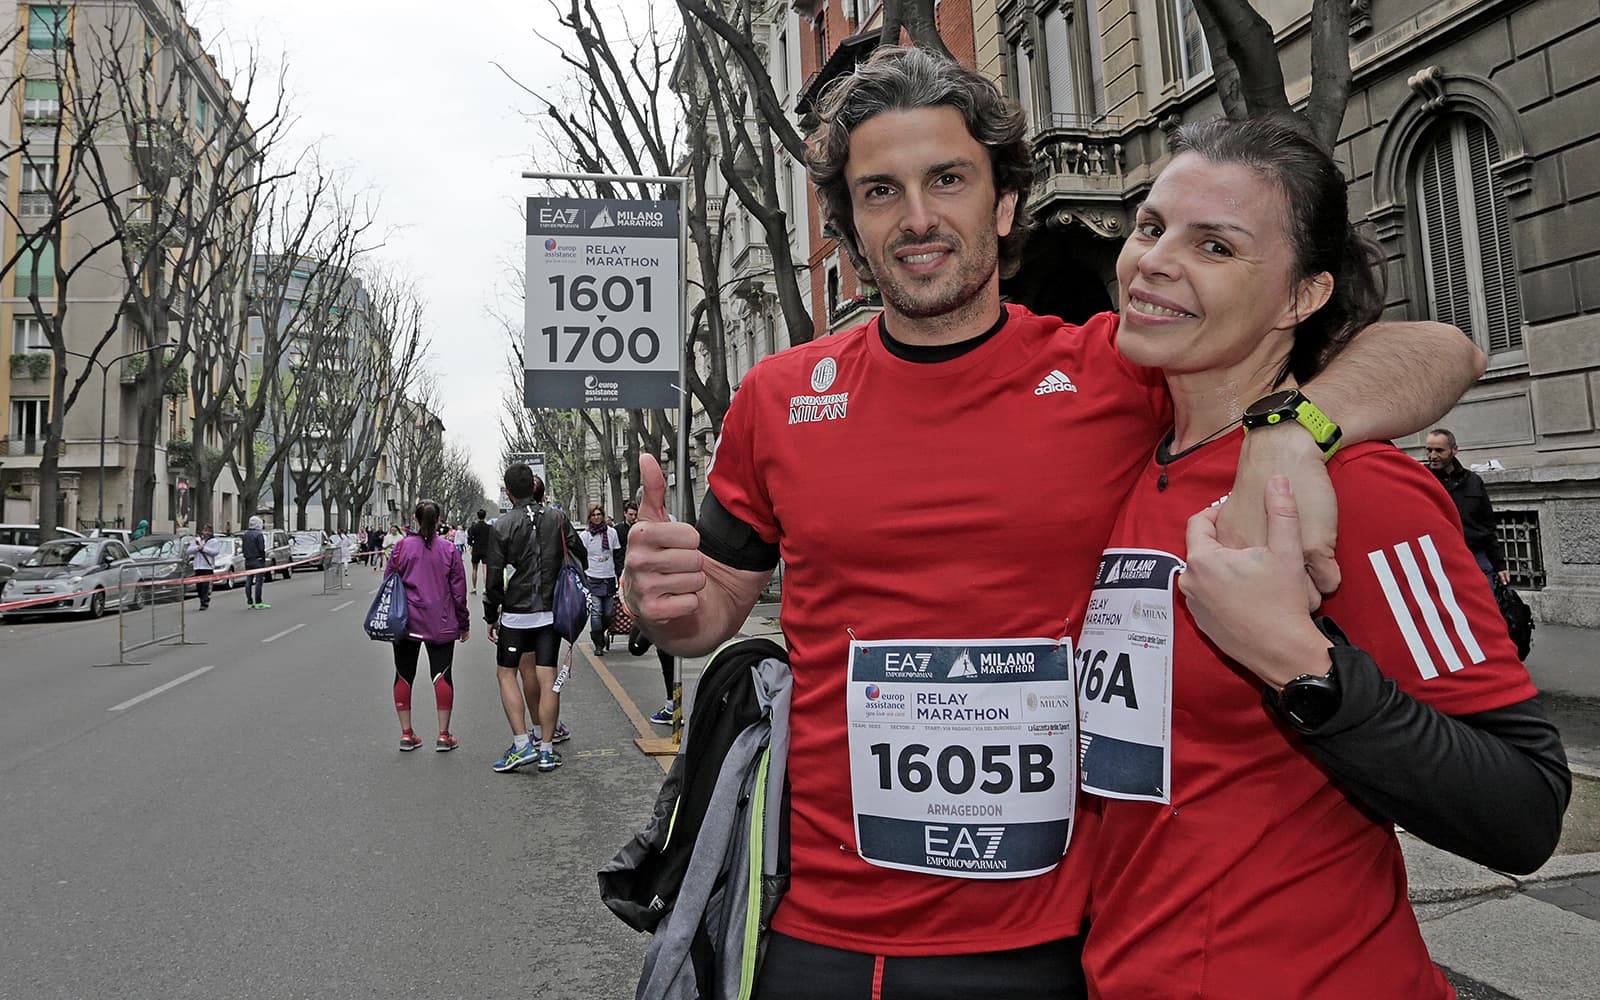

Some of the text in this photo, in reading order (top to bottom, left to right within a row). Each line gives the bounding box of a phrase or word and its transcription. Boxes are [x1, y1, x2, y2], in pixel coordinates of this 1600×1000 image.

[540, 208, 579, 224] EA7
[617, 211, 663, 221] MILANO
[617, 219, 663, 228] MARATHON
[586, 245, 626, 255] RELAY
[586, 257, 659, 267] MARATHON
[548, 275, 652, 313] 1601
[542, 326, 660, 364] 1700
[1034, 383, 1078, 396] adidas
[790, 392, 849, 408] FONDAZIONE
[788, 402, 848, 425] MILAN
[1122, 559, 1157, 572] MILANO
[1142, 608, 1168, 620] MILAN
[886, 652, 933, 672] EA7
[980, 652, 1035, 666] MILANO
[980, 664, 1035, 674] MARATHON
[1075, 648, 1139, 710] 16A
[881, 693, 905, 702] europ
[917, 693, 968, 706] RELAY
[1040, 699, 1069, 708] MILAN
[865, 701, 905, 710] assistance
[917, 708, 1009, 721] MARATHON
[870, 742, 1056, 795] 1605B
[927, 804, 1003, 817] ARMAGEDDON
[925, 825, 1006, 859] EA7
[926, 856, 1007, 869] EMPORIO ARMANI
